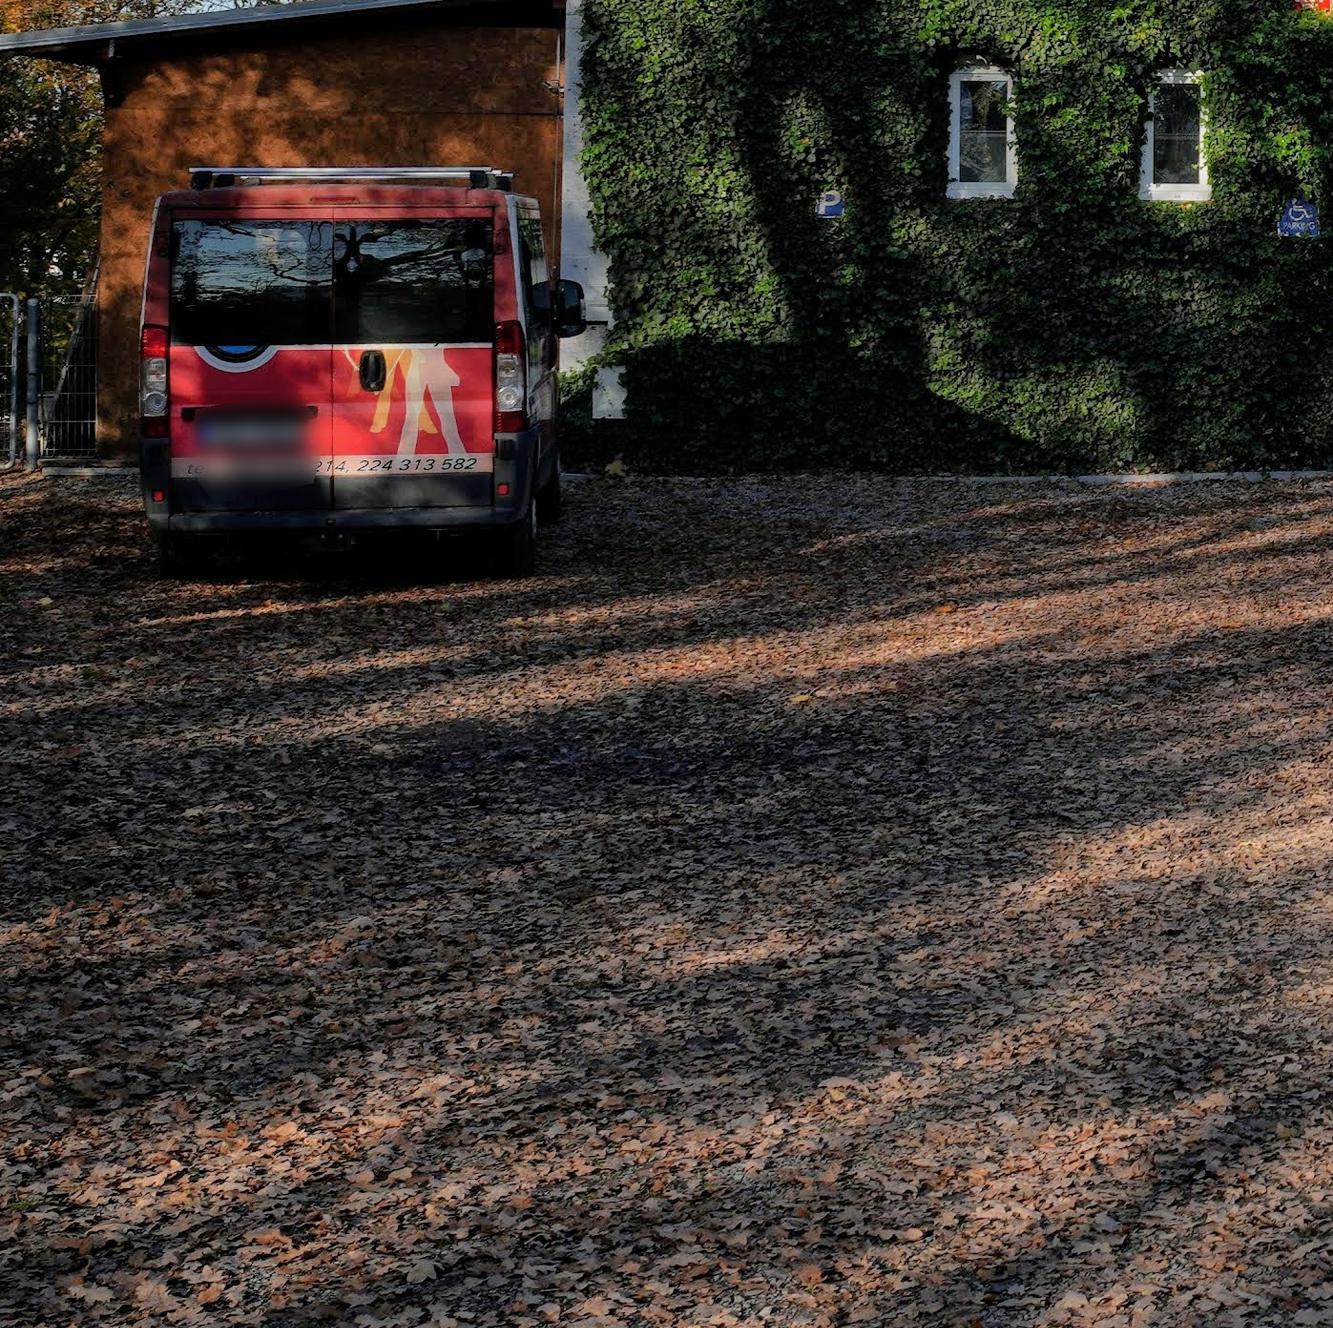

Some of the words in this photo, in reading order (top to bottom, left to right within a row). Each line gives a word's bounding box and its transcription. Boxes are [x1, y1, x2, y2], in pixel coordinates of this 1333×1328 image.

[819, 189, 841, 215] P
[357, 459, 393, 471] 224
[399, 458, 434, 471] 313
[441, 458, 477, 470] 582
